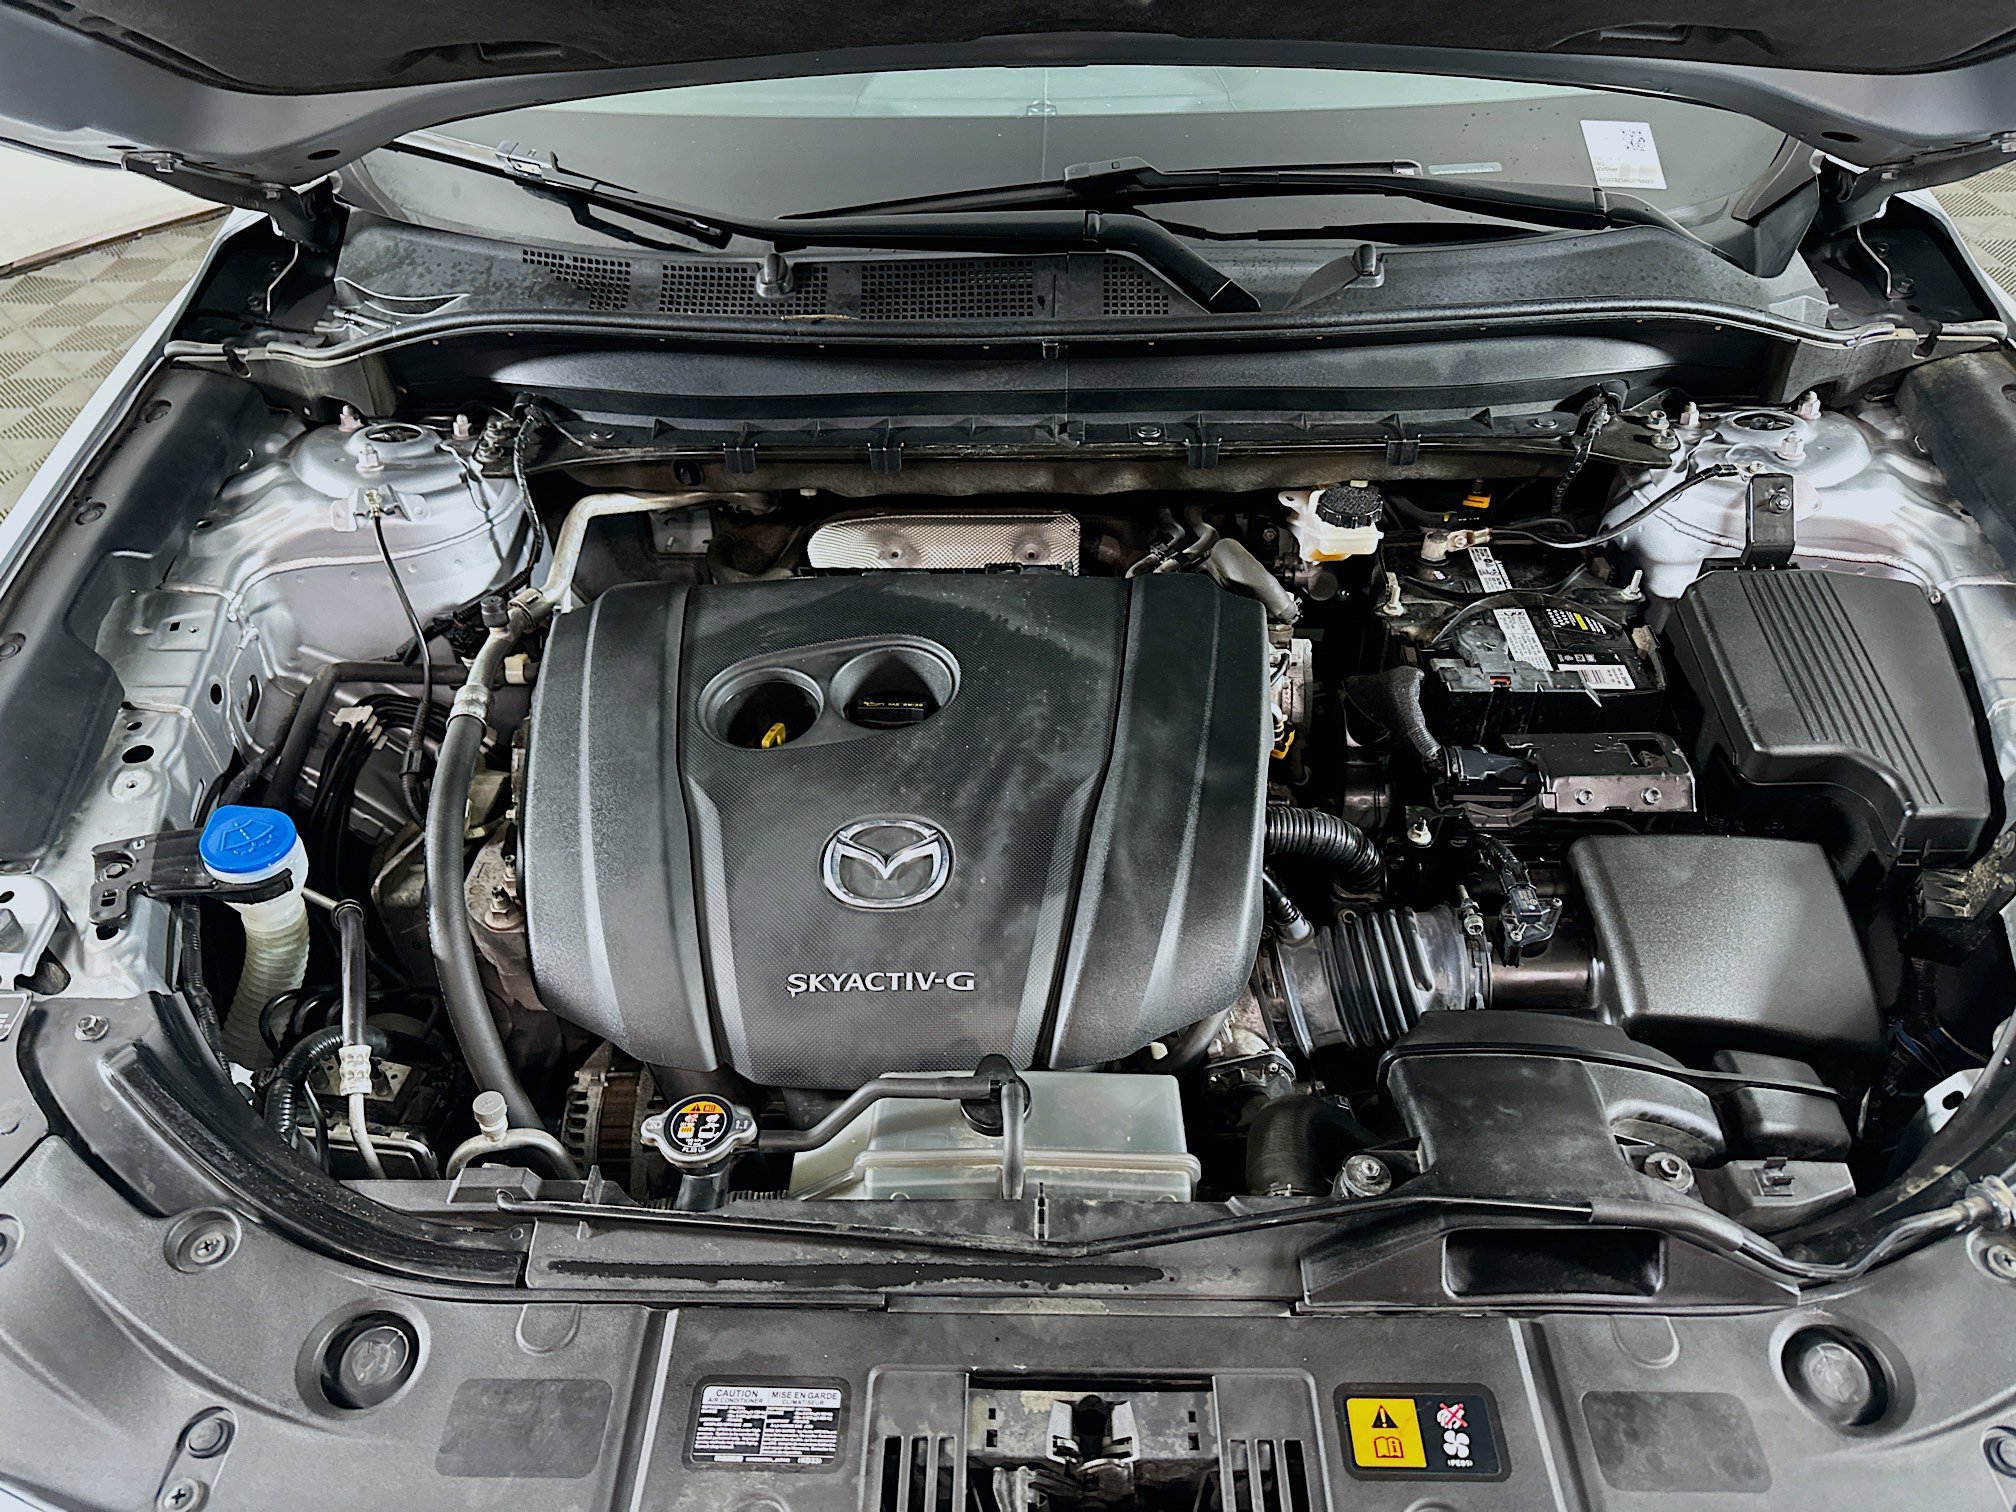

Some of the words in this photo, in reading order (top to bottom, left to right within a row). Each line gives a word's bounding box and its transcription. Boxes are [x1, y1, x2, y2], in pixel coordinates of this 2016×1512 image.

[786, 971, 975, 998] SKYACTIV-G
[716, 1389, 758, 1398] CAUTION
[772, 1391, 792, 1399] MISE
[794, 1391, 806, 1399] EN
[807, 1392, 838, 1400] GARDE
